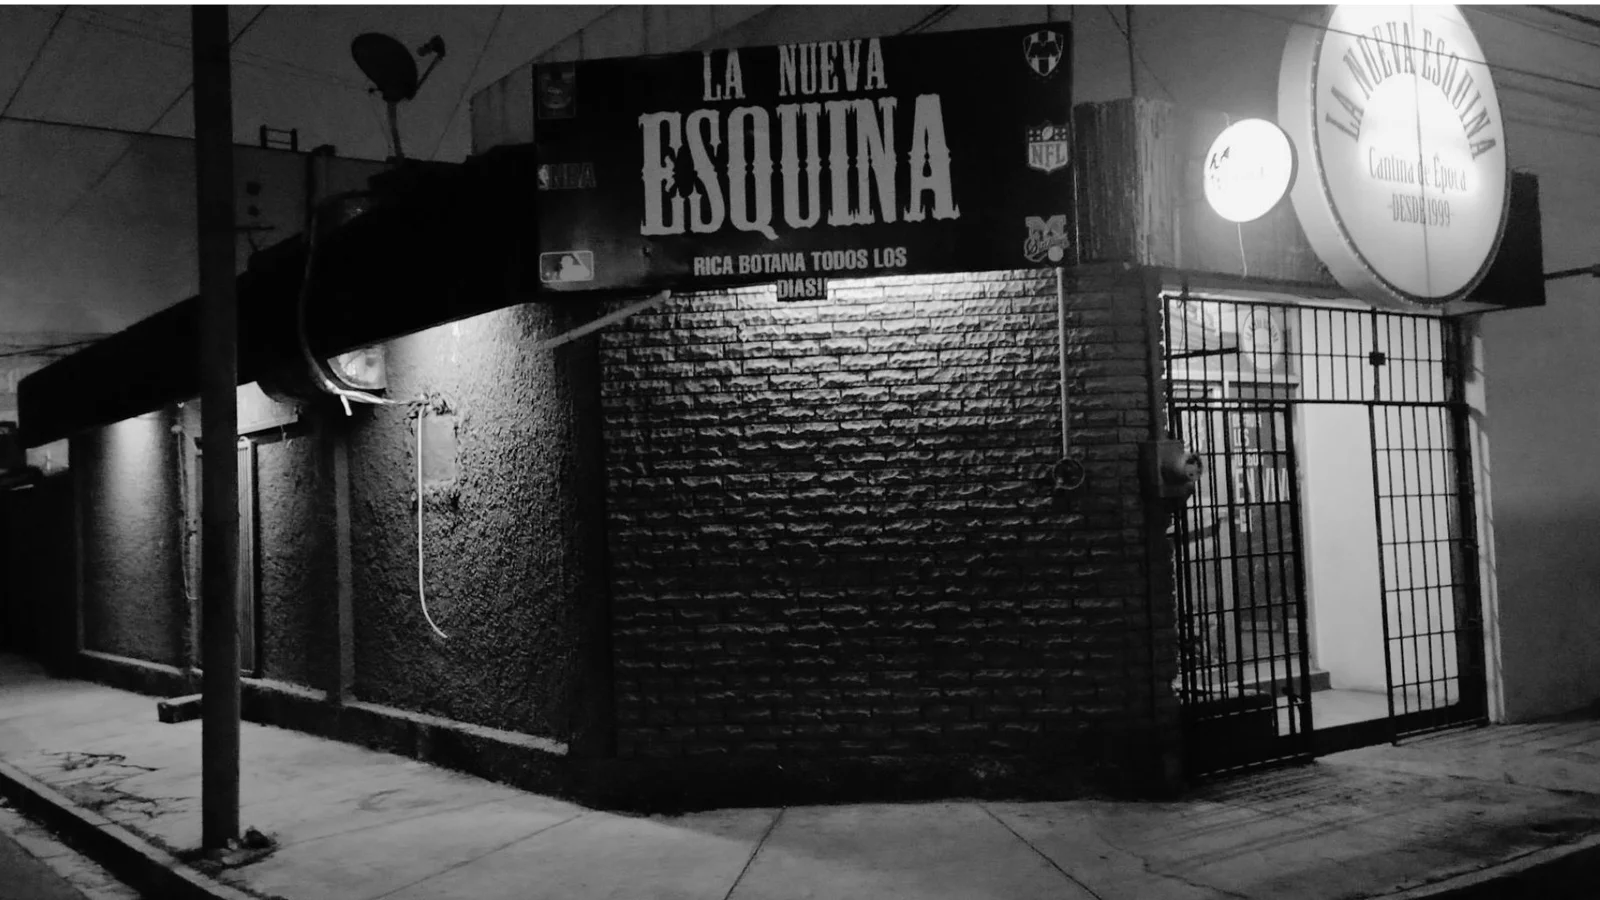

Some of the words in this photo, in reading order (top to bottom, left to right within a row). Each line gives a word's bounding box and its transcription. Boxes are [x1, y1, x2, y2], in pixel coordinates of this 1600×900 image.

[701, 48, 746, 102] LA
[778, 37, 888, 97] NUEVA
[1343, 21, 1416, 100] NUEVA
[1325, 85, 1365, 142] LA
[1422, 28, 1497, 160] ESQUINA
[637, 93, 961, 241] ESQUINA
[1031, 143, 1066, 168] NFL
[1369, 146, 1415, 184] Cantina
[1416, 155, 1430, 188] de
[693, 255, 735, 277] RICA
[738, 252, 806, 275] BOTANA
[810, 249, 869, 272] TODOS
[873, 247, 907, 269] LOS
